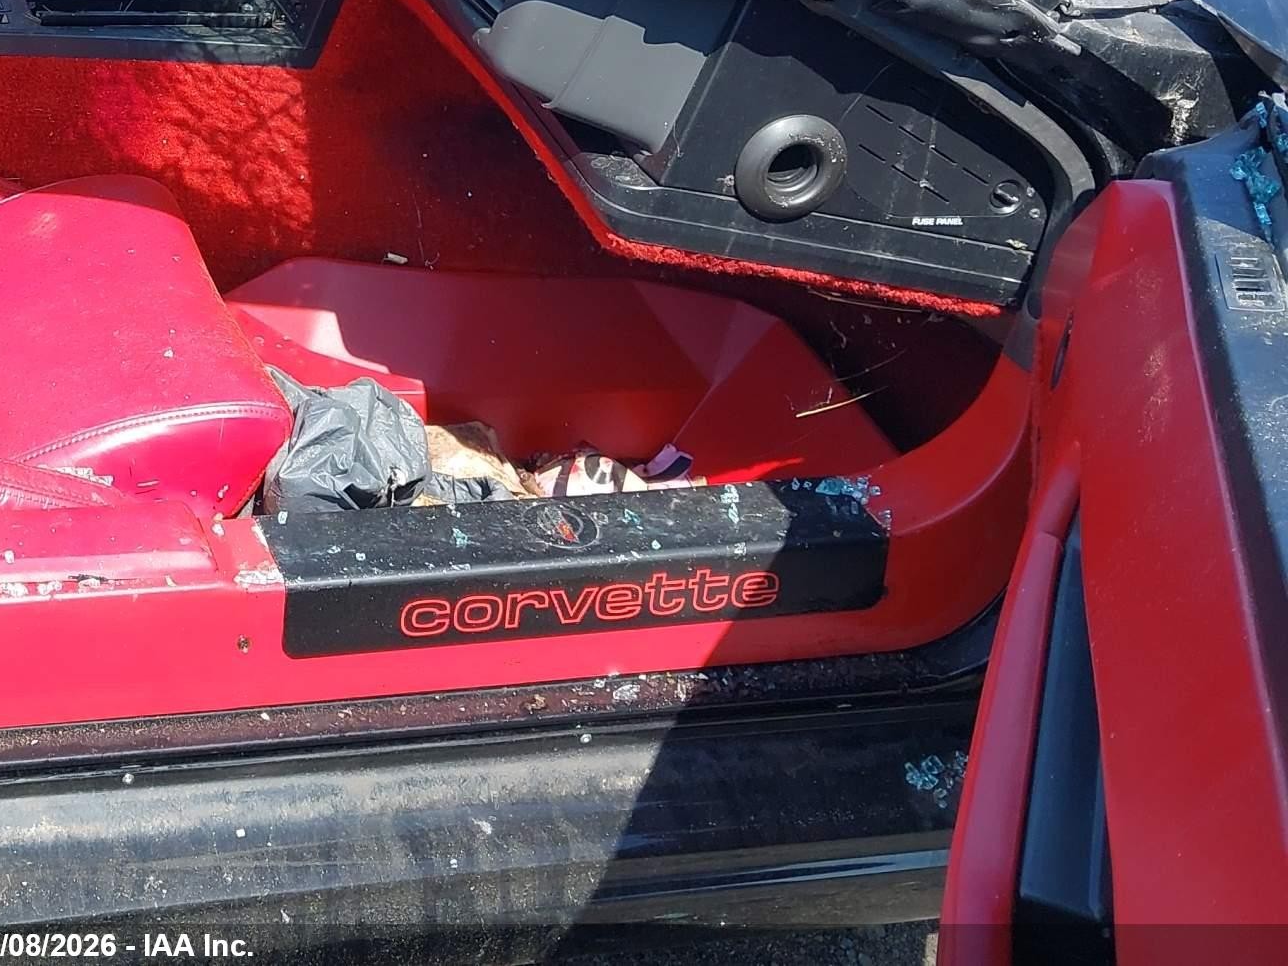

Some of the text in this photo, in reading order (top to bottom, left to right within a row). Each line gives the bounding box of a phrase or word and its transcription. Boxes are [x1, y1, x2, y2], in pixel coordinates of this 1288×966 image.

[912, 217, 964, 226] FUSE PANEL
[400, 568, 781, 637] corvette
